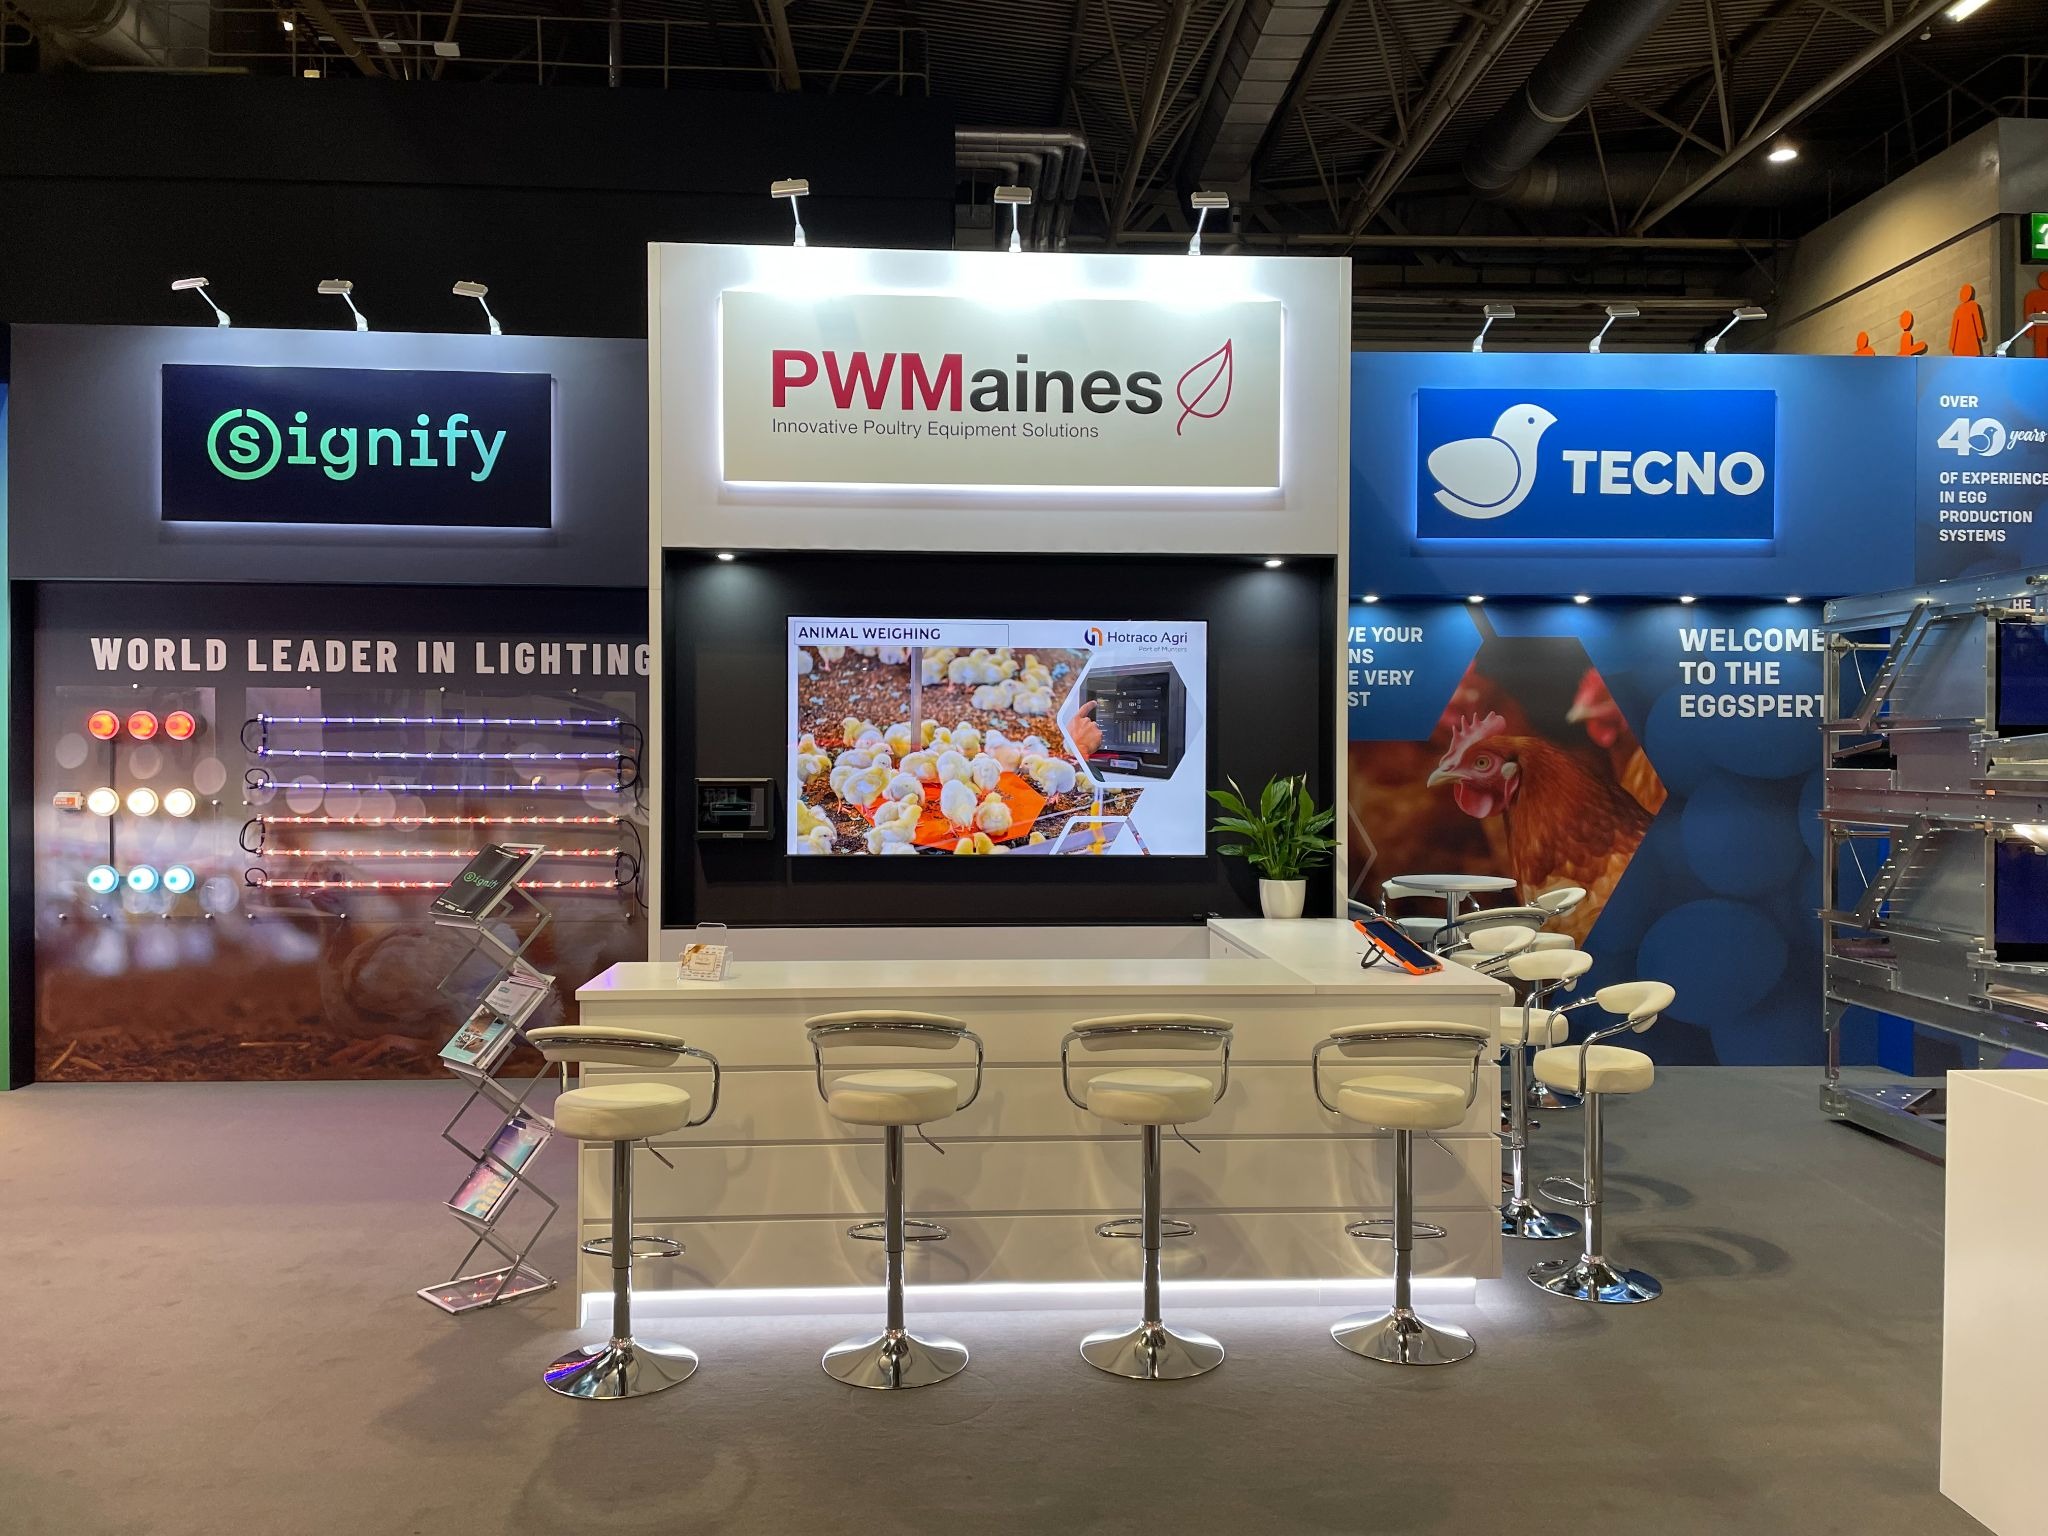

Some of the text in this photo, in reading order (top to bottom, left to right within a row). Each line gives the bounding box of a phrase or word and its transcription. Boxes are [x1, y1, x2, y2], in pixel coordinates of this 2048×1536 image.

[772, 350, 1163, 415] PWMaines
[1939, 395, 1979, 408] OVER
[772, 419, 1099, 440] Innovative Poultry Equipment Solutions
[1937, 417, 2048, 457] 40 years
[207, 409, 507, 482] signify
[1562, 450, 1765, 496] TECNO
[1939, 471, 2048, 485] OF EXPERIENCE
[1939, 491, 1987, 504] IN EGG
[1939, 510, 2033, 523] PRODUCTION
[1939, 529, 2006, 542] SYSTEMS
[798, 627, 941, 640] ANIMAL WEIGHING
[1107, 631, 1188, 646] Hotraco Agri
[1371, 627, 1423, 643] YOUR
[1679, 628, 1824, 652] WELCOME
[91, 637, 649, 676] WORLD LEADER IN LIGHTING
[1364, 669, 1414, 686] VERY
[1679, 661, 1780, 685] TO THE
[1680, 694, 1824, 718] EGGSPERT
